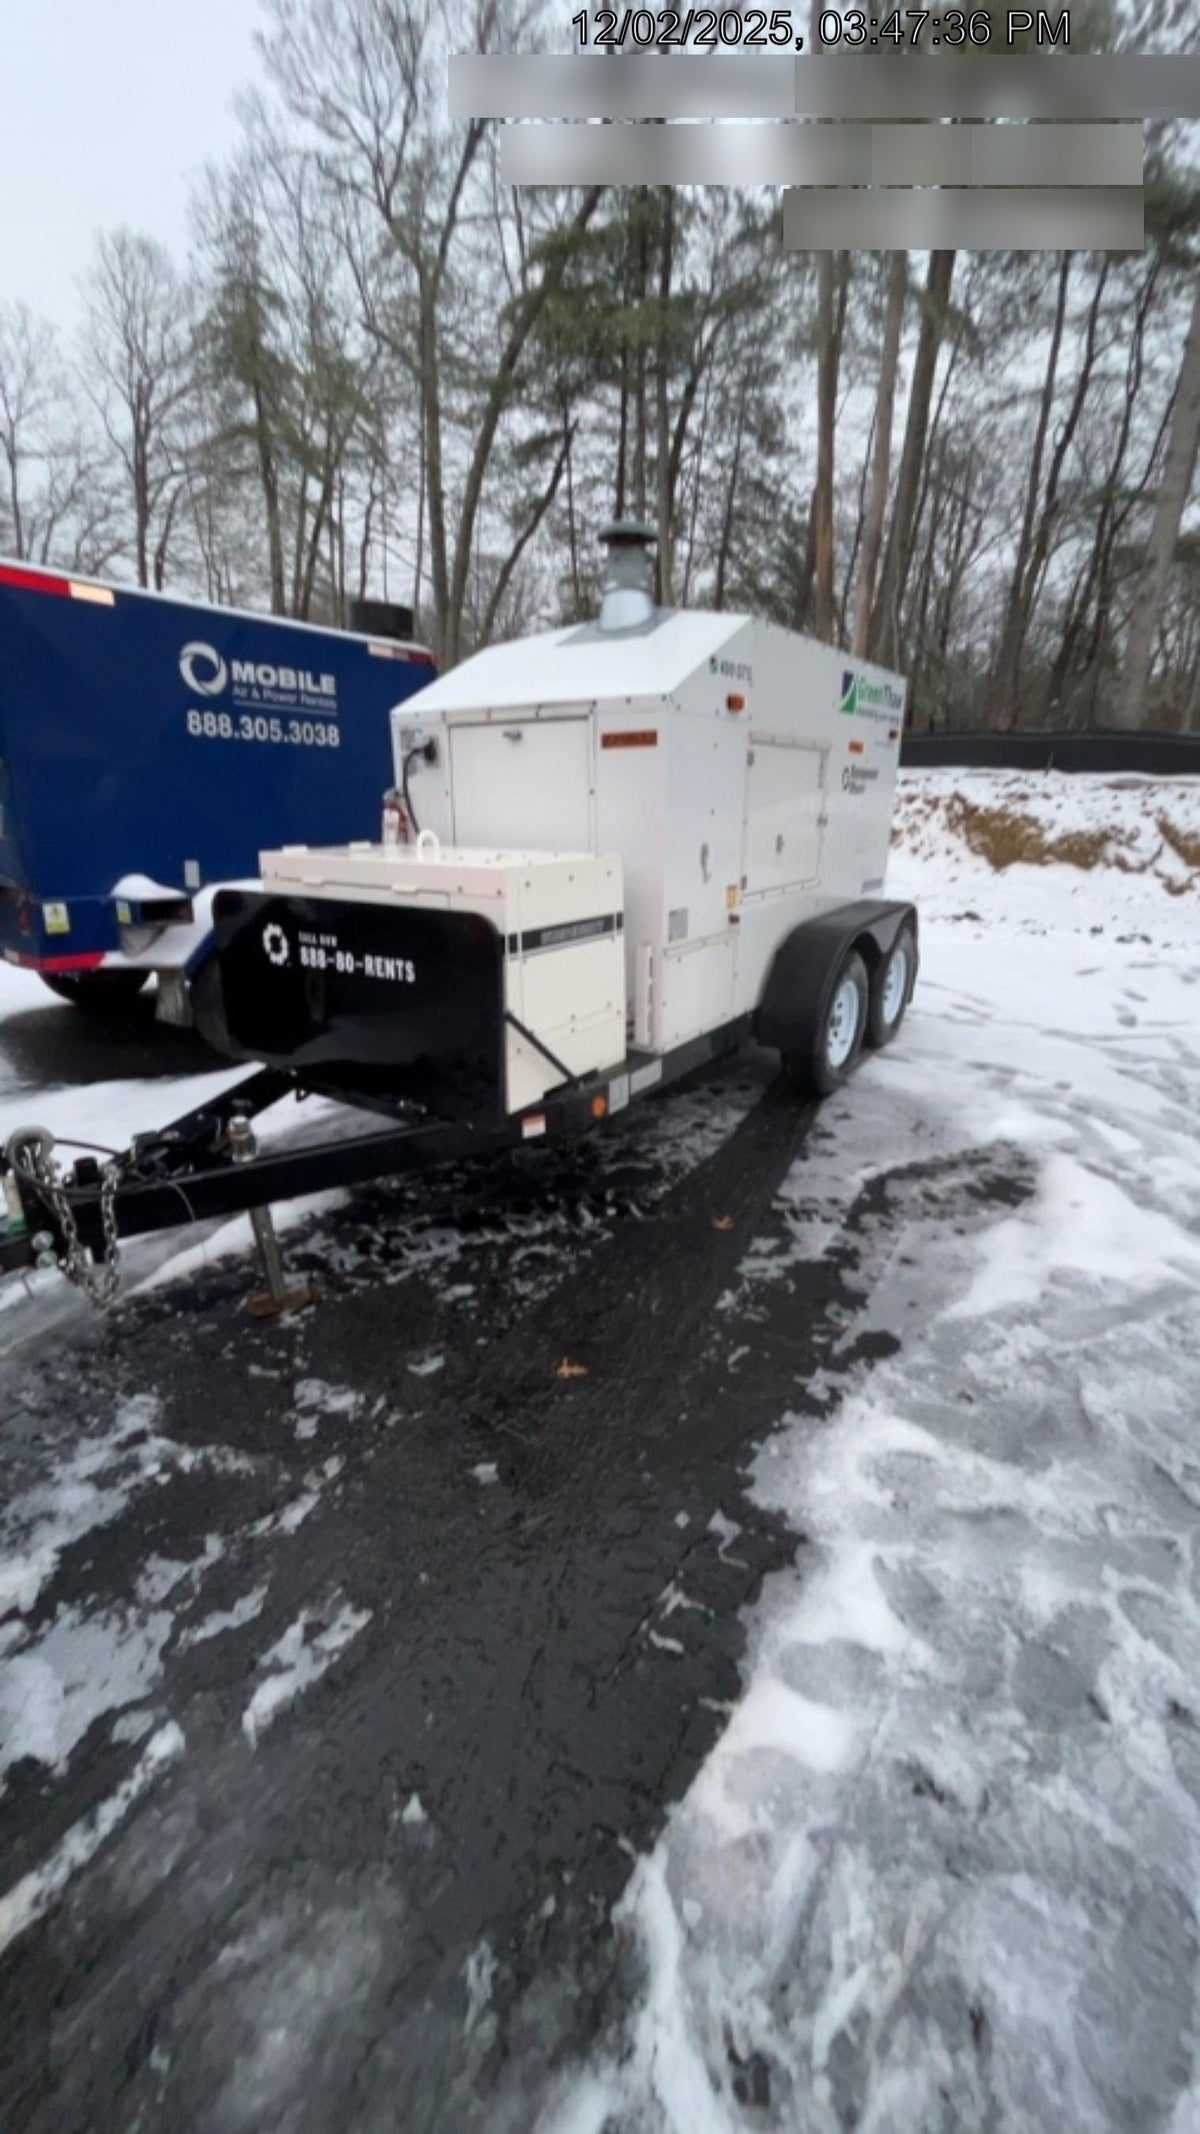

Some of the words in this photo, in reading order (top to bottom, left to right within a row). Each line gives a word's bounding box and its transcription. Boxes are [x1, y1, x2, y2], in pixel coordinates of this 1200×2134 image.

[231, 659, 336, 696] MOBILE
[187, 708, 340, 748] 888.305.3038
[300, 945, 416, 983] 888-80-RENTS
